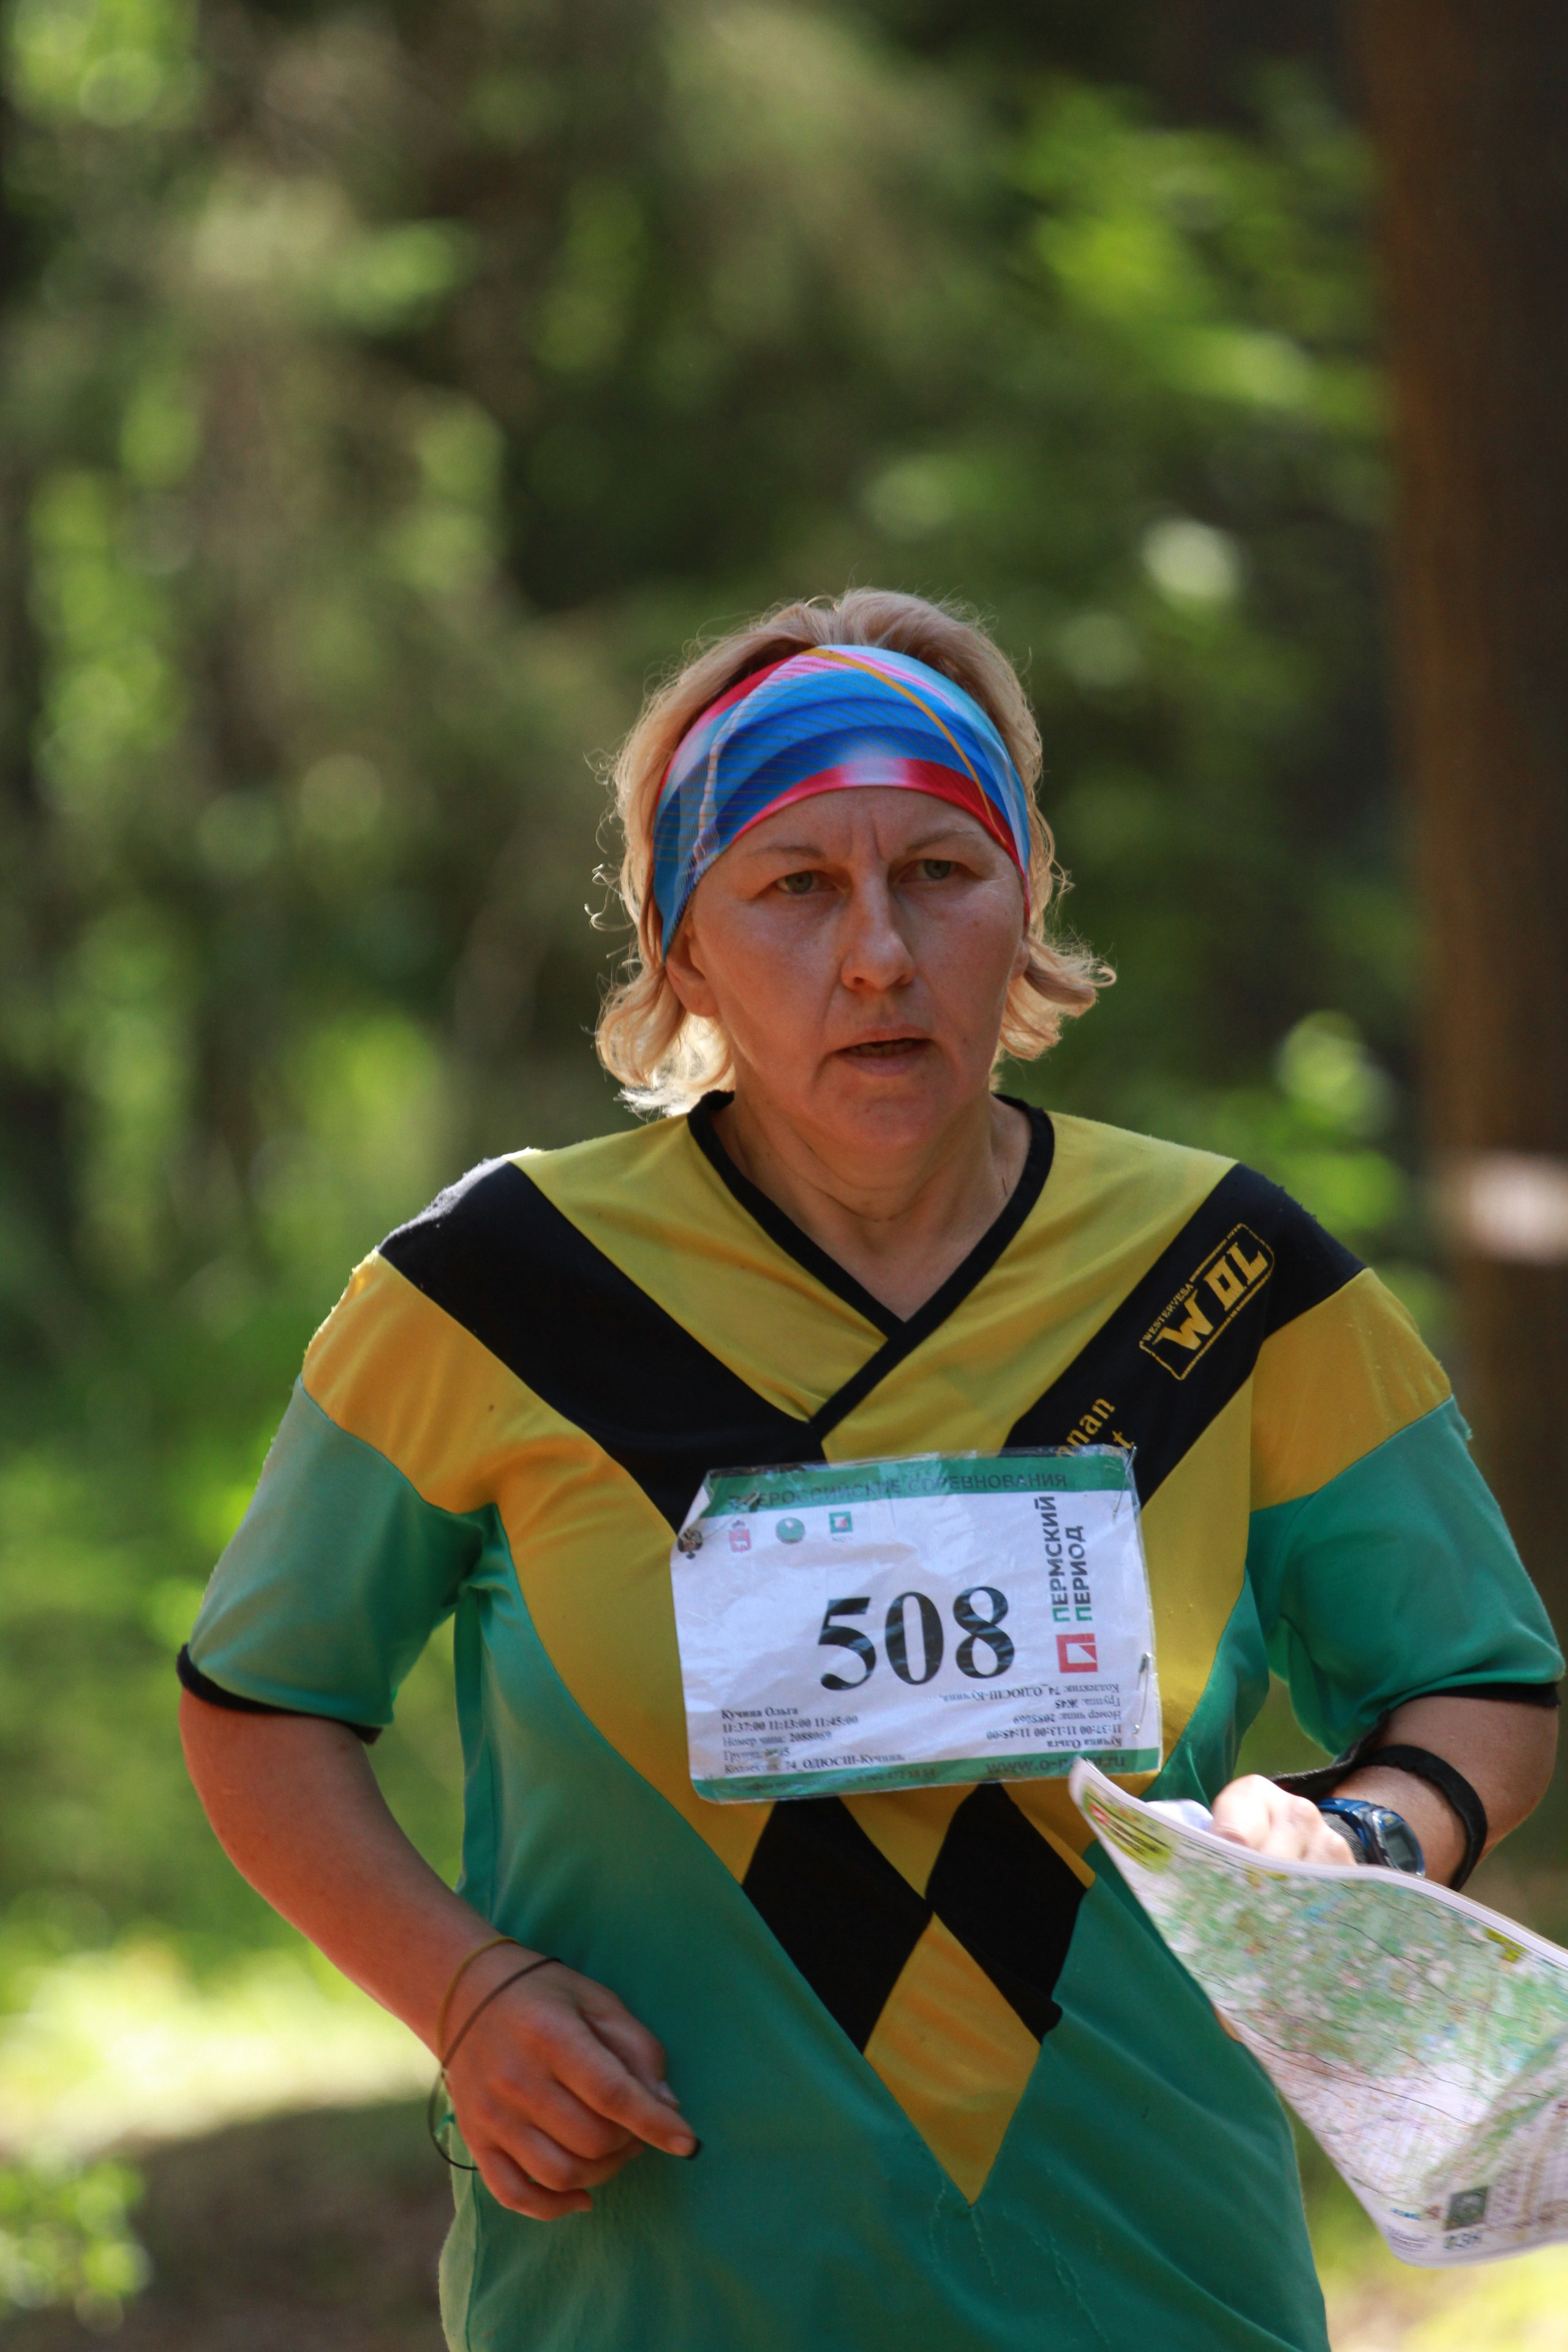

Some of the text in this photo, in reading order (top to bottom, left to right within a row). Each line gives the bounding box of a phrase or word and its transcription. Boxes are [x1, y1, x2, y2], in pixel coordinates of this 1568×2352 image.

[1034, 1496, 1071, 1622] ПЕРМСКИЙ
[1065, 1525, 1093, 1621] ПЕРИОД
[818, 1586, 1015, 1691] 508
[1034, 1725, 1077, 1737] 11:13:00
[1079, 1724, 1121, 1735] 11:37:00
